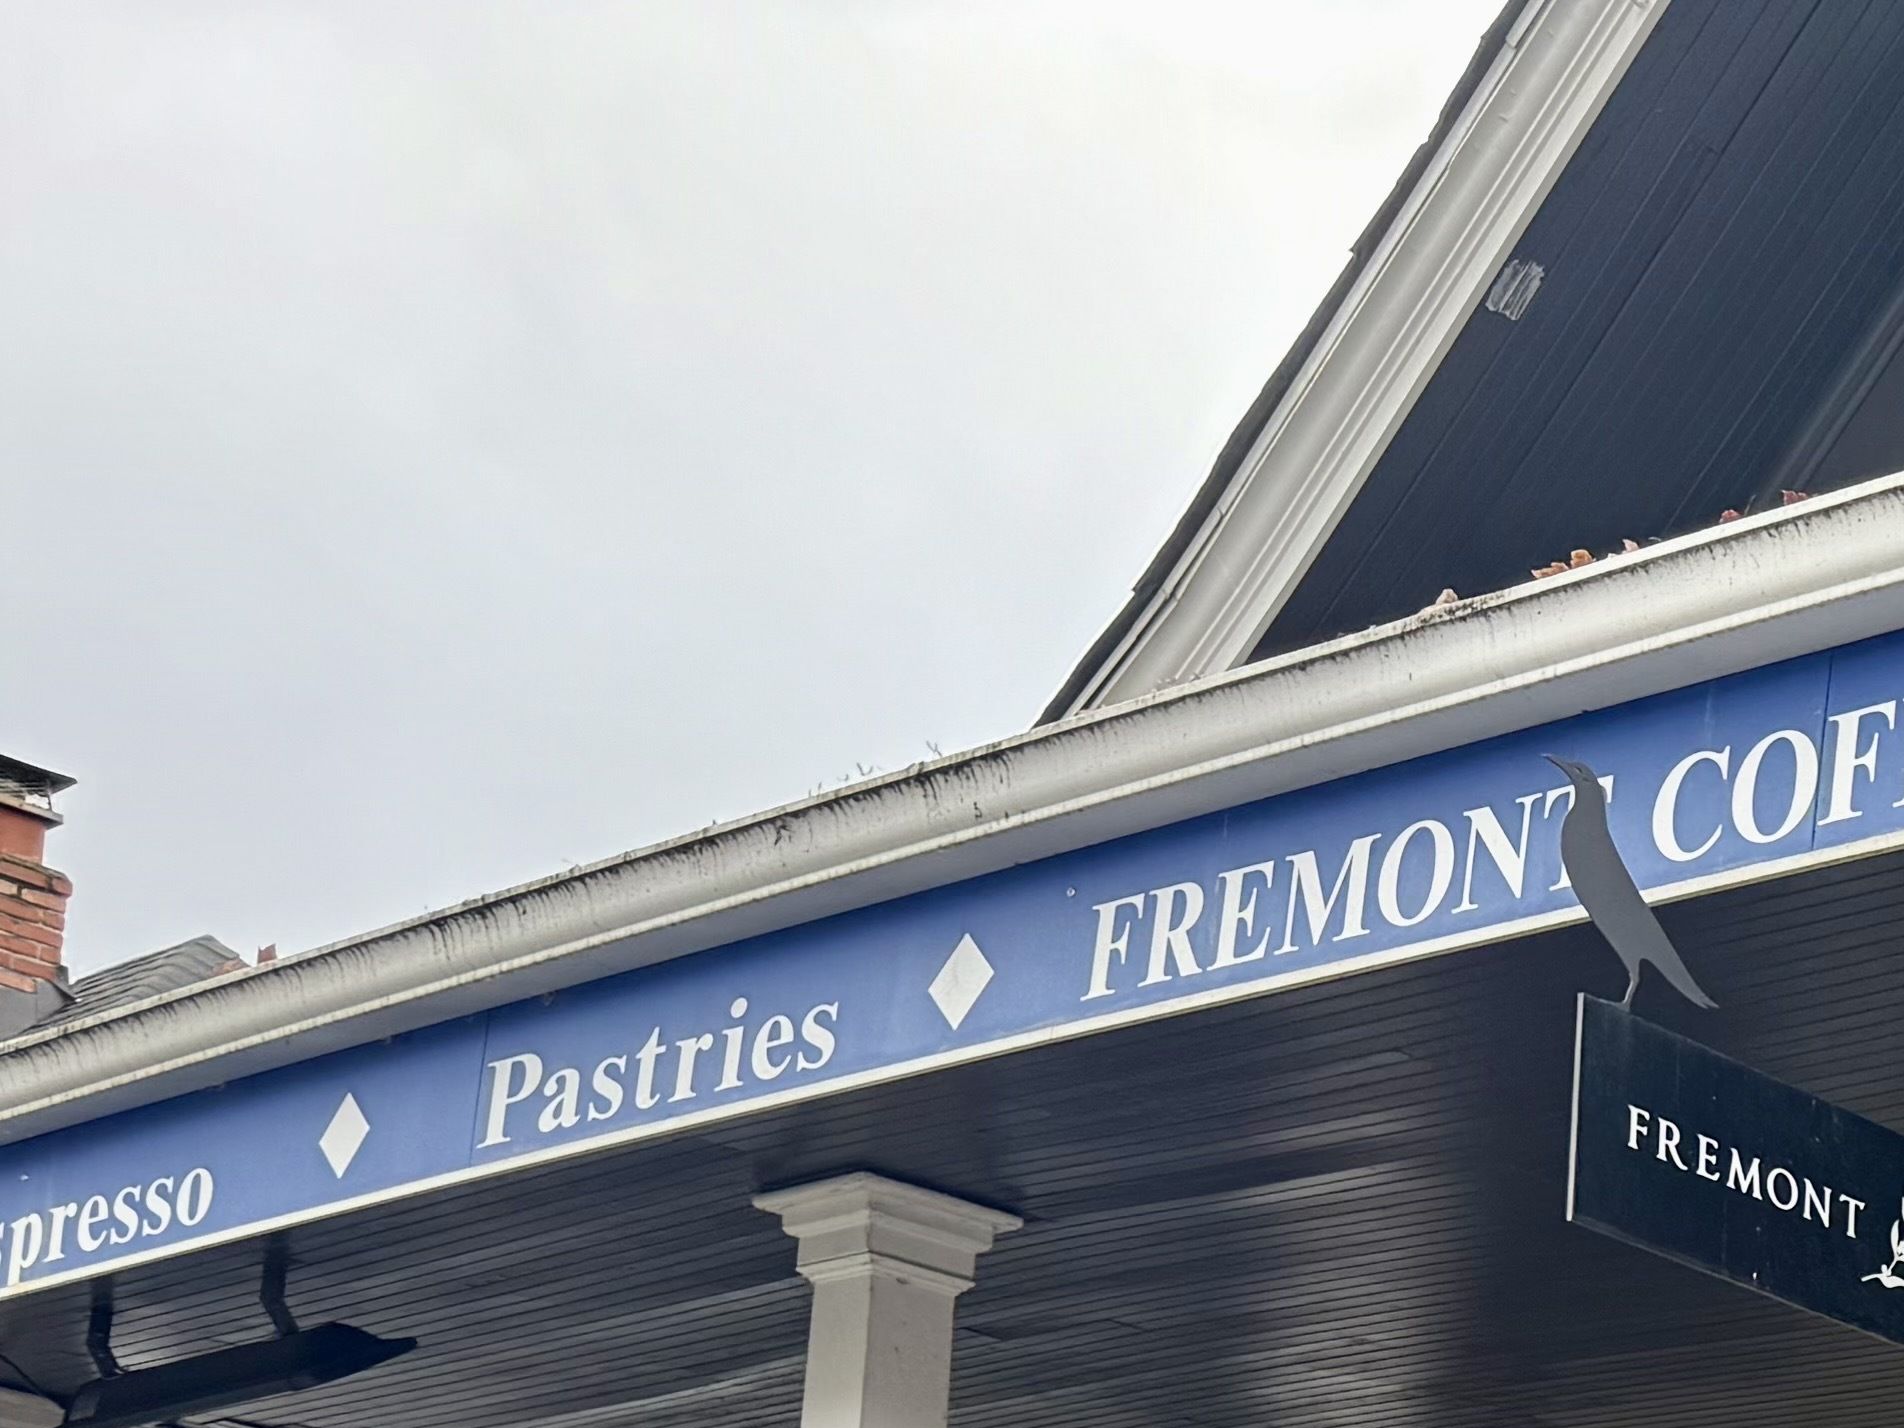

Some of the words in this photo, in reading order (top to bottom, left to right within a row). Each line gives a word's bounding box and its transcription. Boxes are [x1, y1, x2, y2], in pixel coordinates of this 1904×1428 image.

[1080, 774, 1614, 1001] FREMONT
[475, 1000, 840, 1148] Pastries
[0, 1167, 213, 1288] presso
[1627, 1104, 1865, 1238] FREMONT
